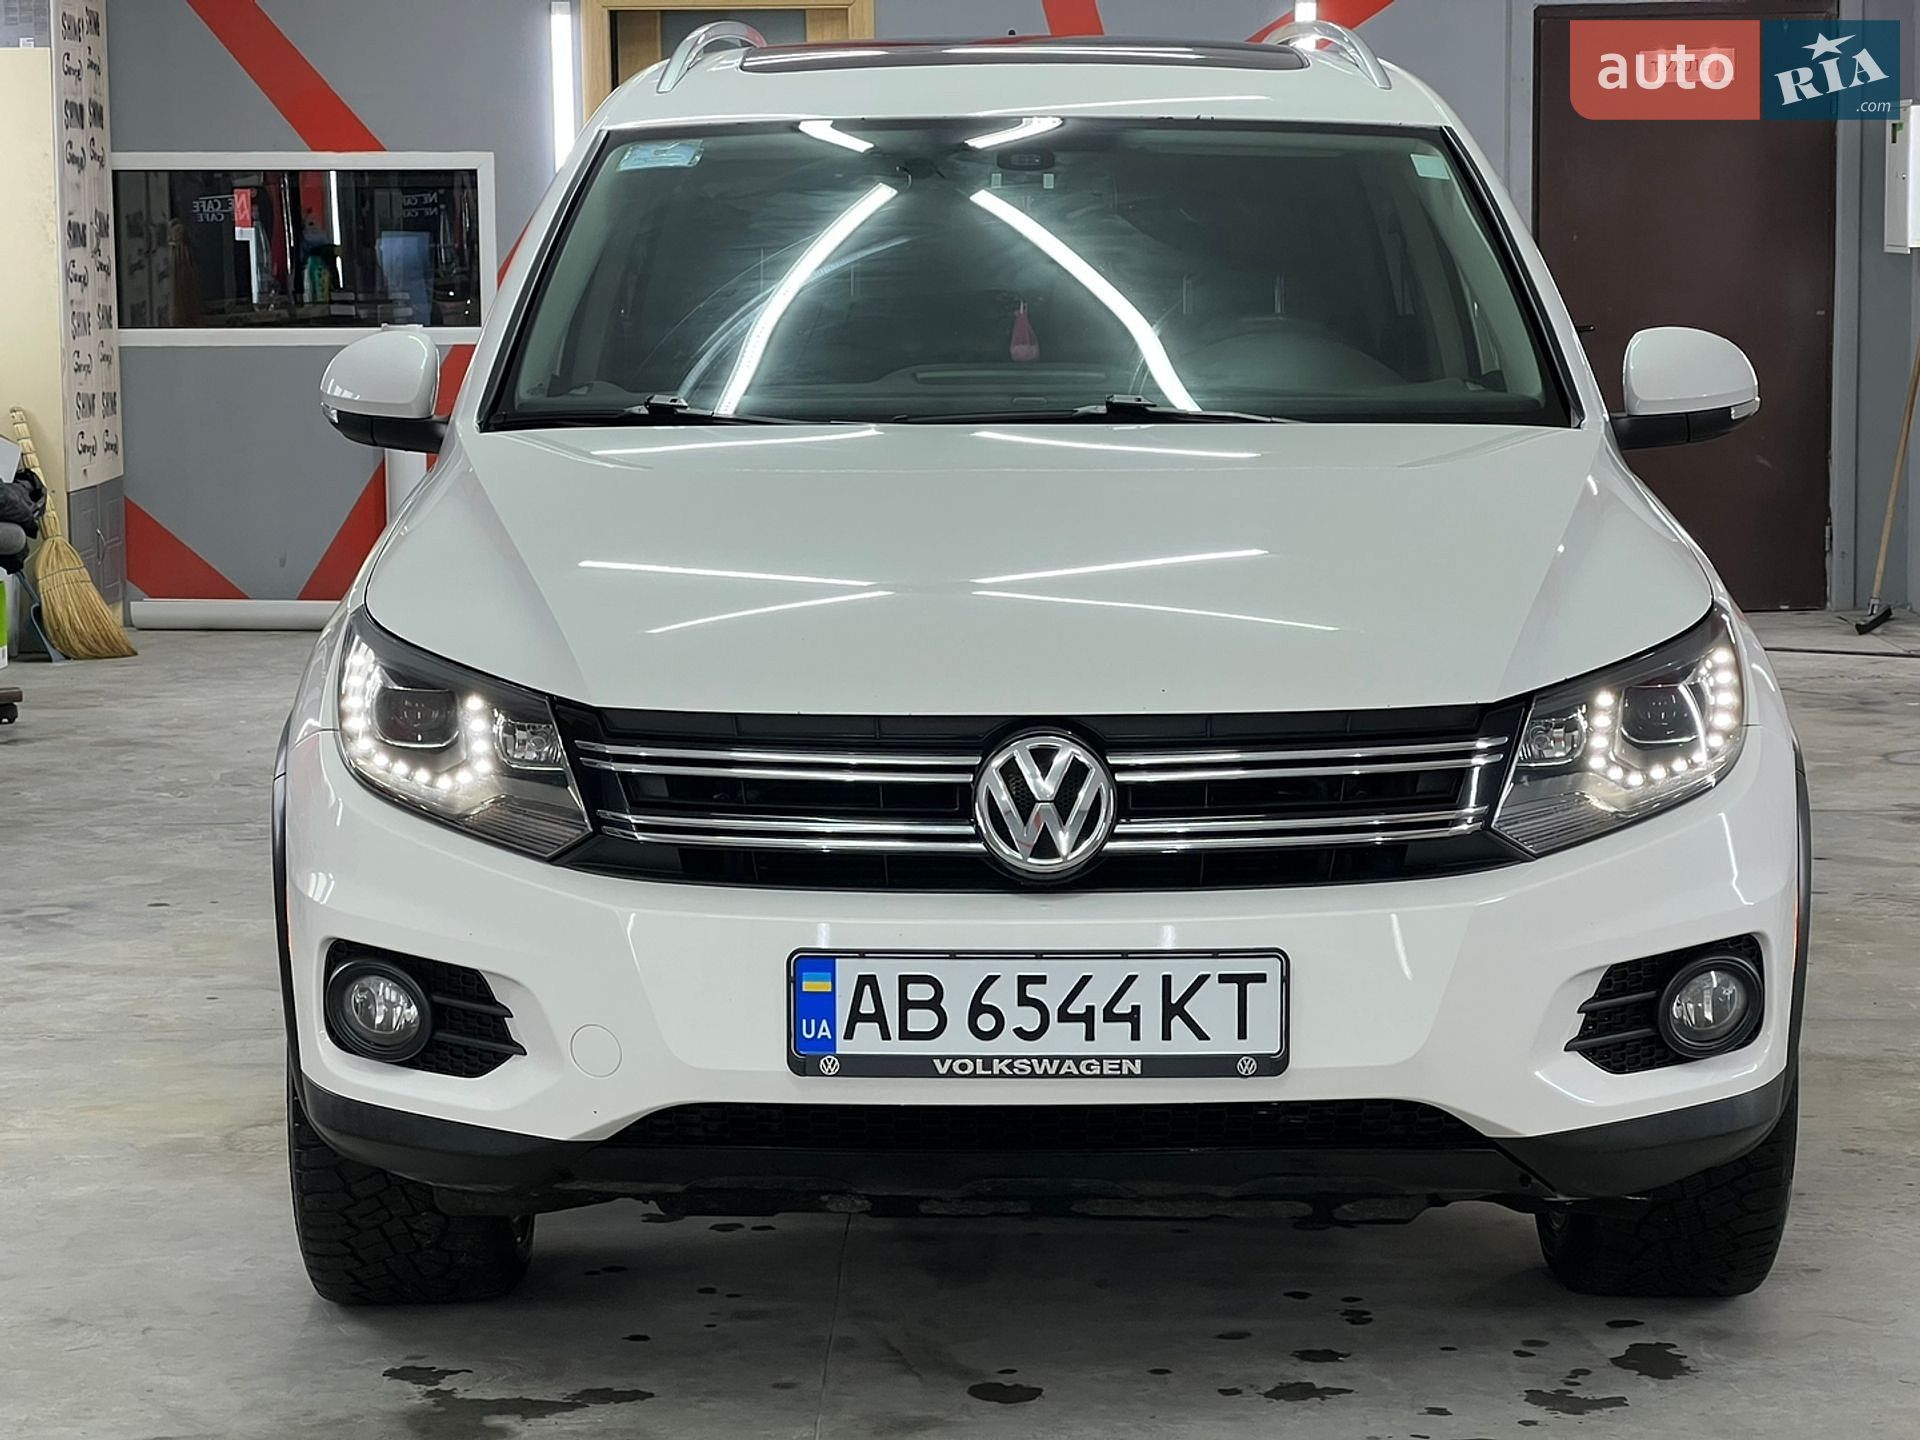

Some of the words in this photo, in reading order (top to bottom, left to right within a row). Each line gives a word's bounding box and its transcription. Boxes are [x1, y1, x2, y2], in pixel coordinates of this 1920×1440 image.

[802, 1019, 832, 1039] UA
[843, 974, 948, 1041] AB
[967, 973, 1141, 1041] 6544
[1161, 973, 1268, 1041] KT
[933, 1058, 1142, 1076] VOLKSWAGEN
